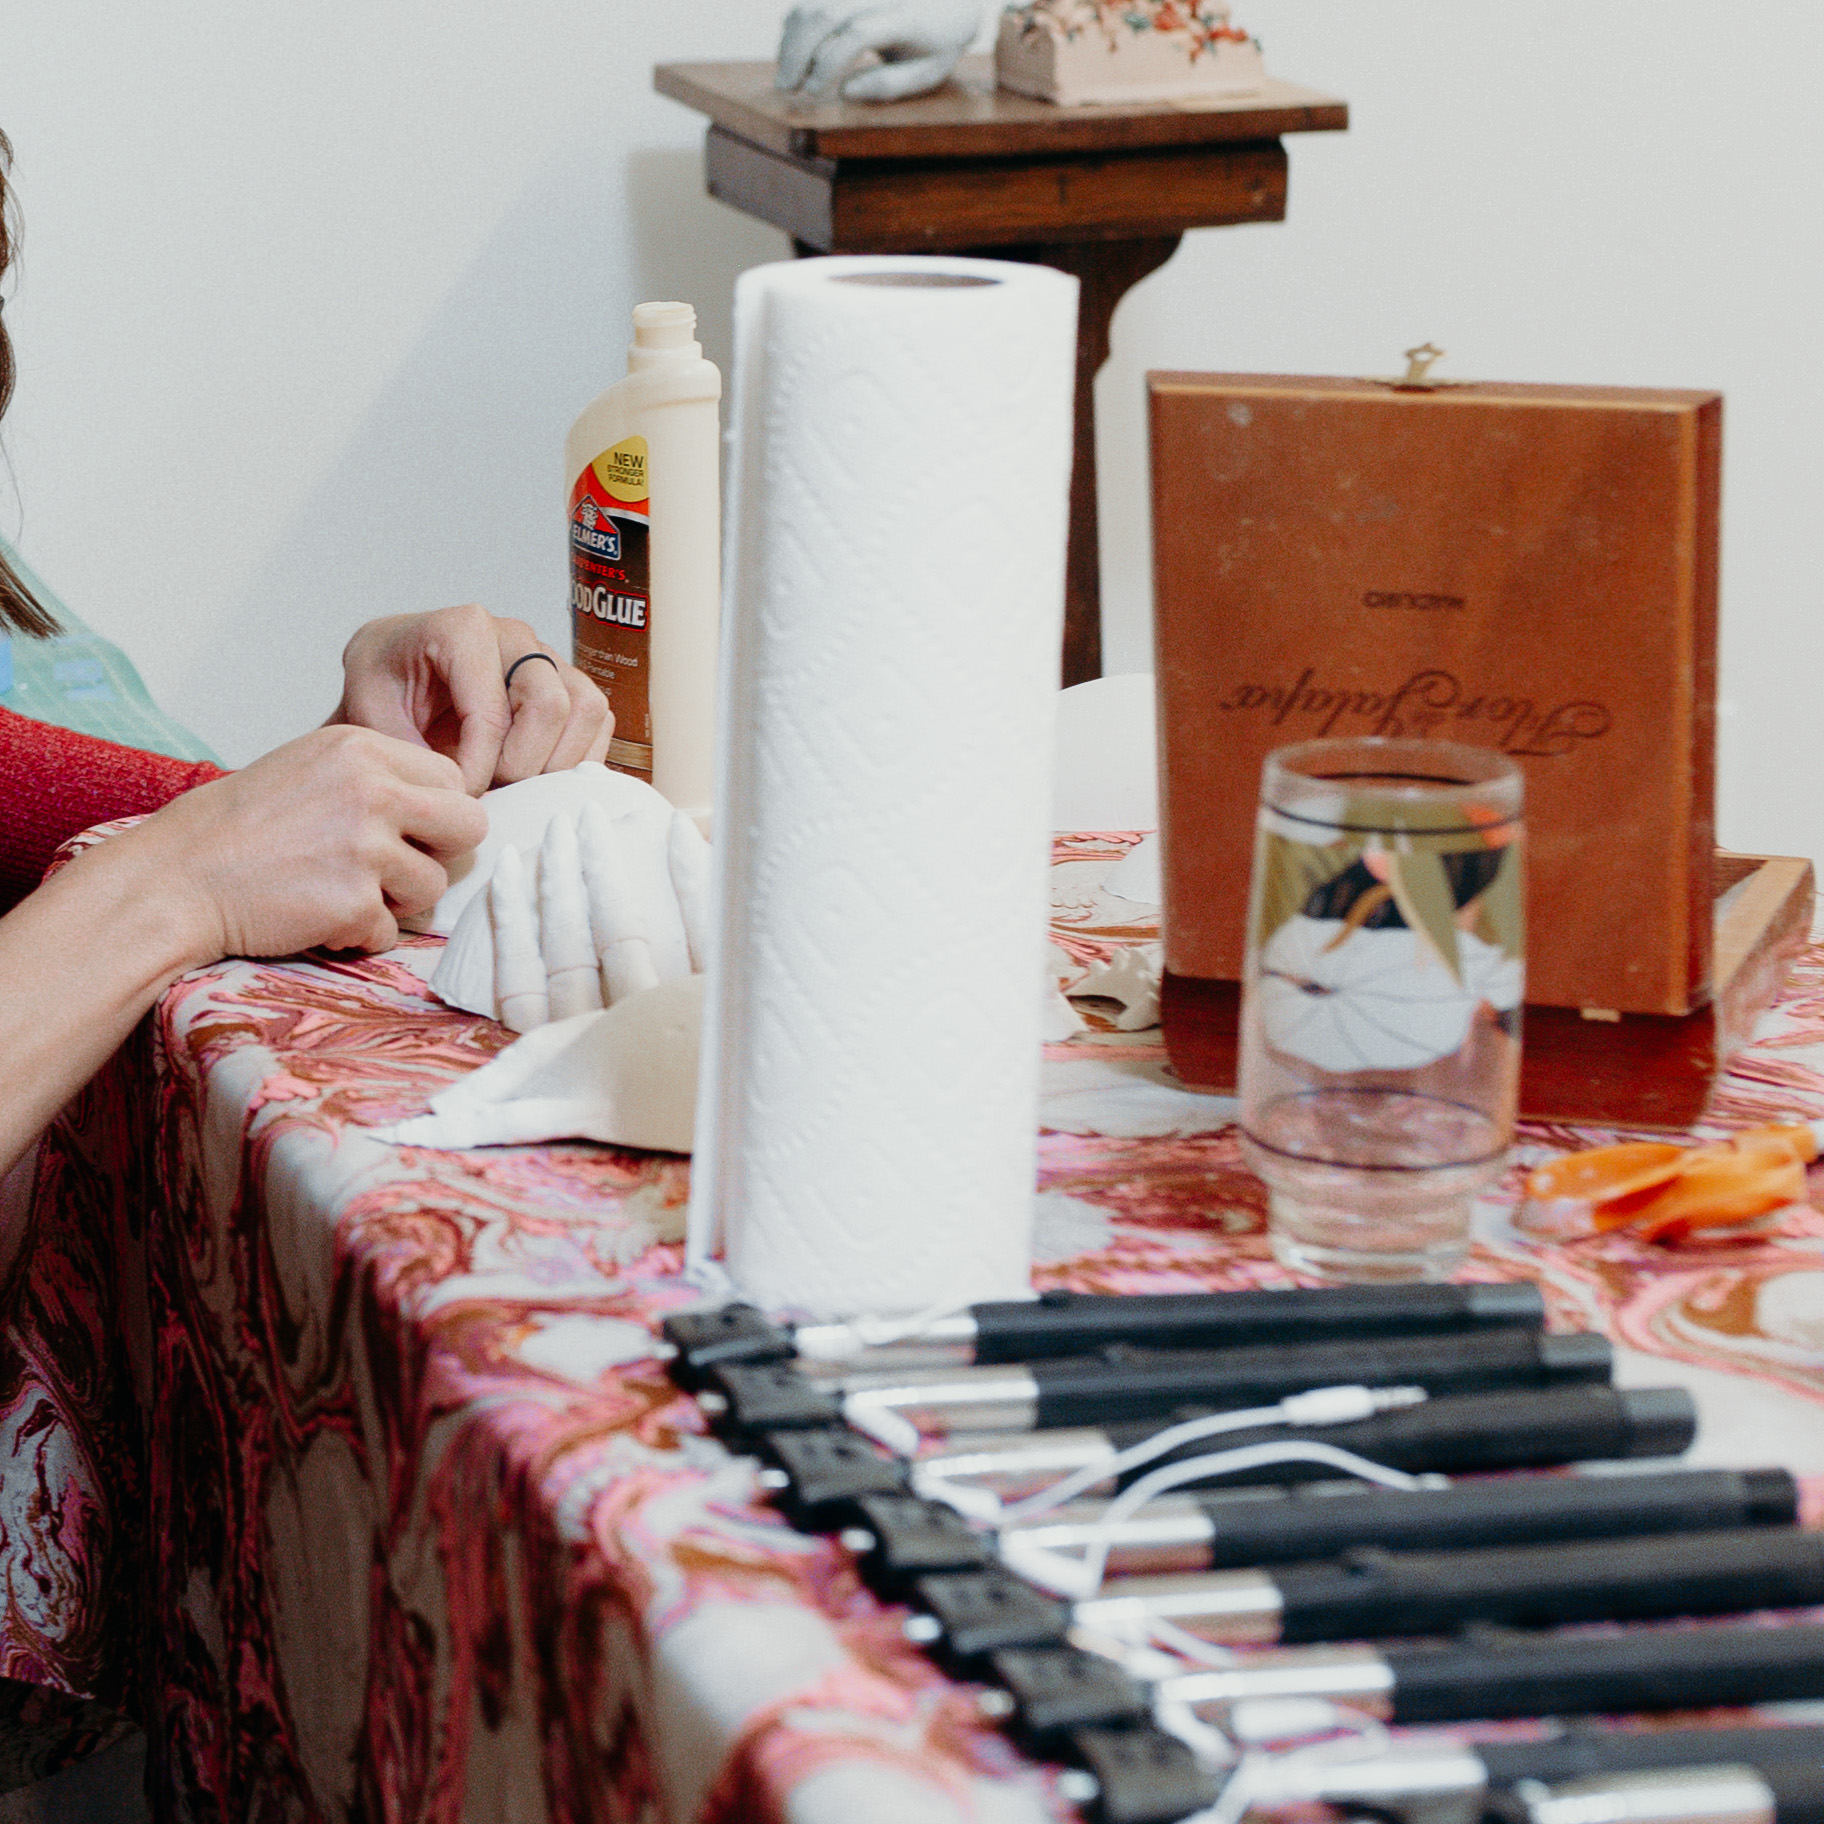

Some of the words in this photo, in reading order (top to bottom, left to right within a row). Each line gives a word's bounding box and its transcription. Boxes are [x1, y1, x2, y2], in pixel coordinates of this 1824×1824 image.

[613, 451, 644, 469] NEW
[607, 464, 644, 478] STRONGER
[572, 523, 617, 553] ELMER'S
[613, 653, 639, 668] Wood
[1455, 695, 1613, 758] Flor
